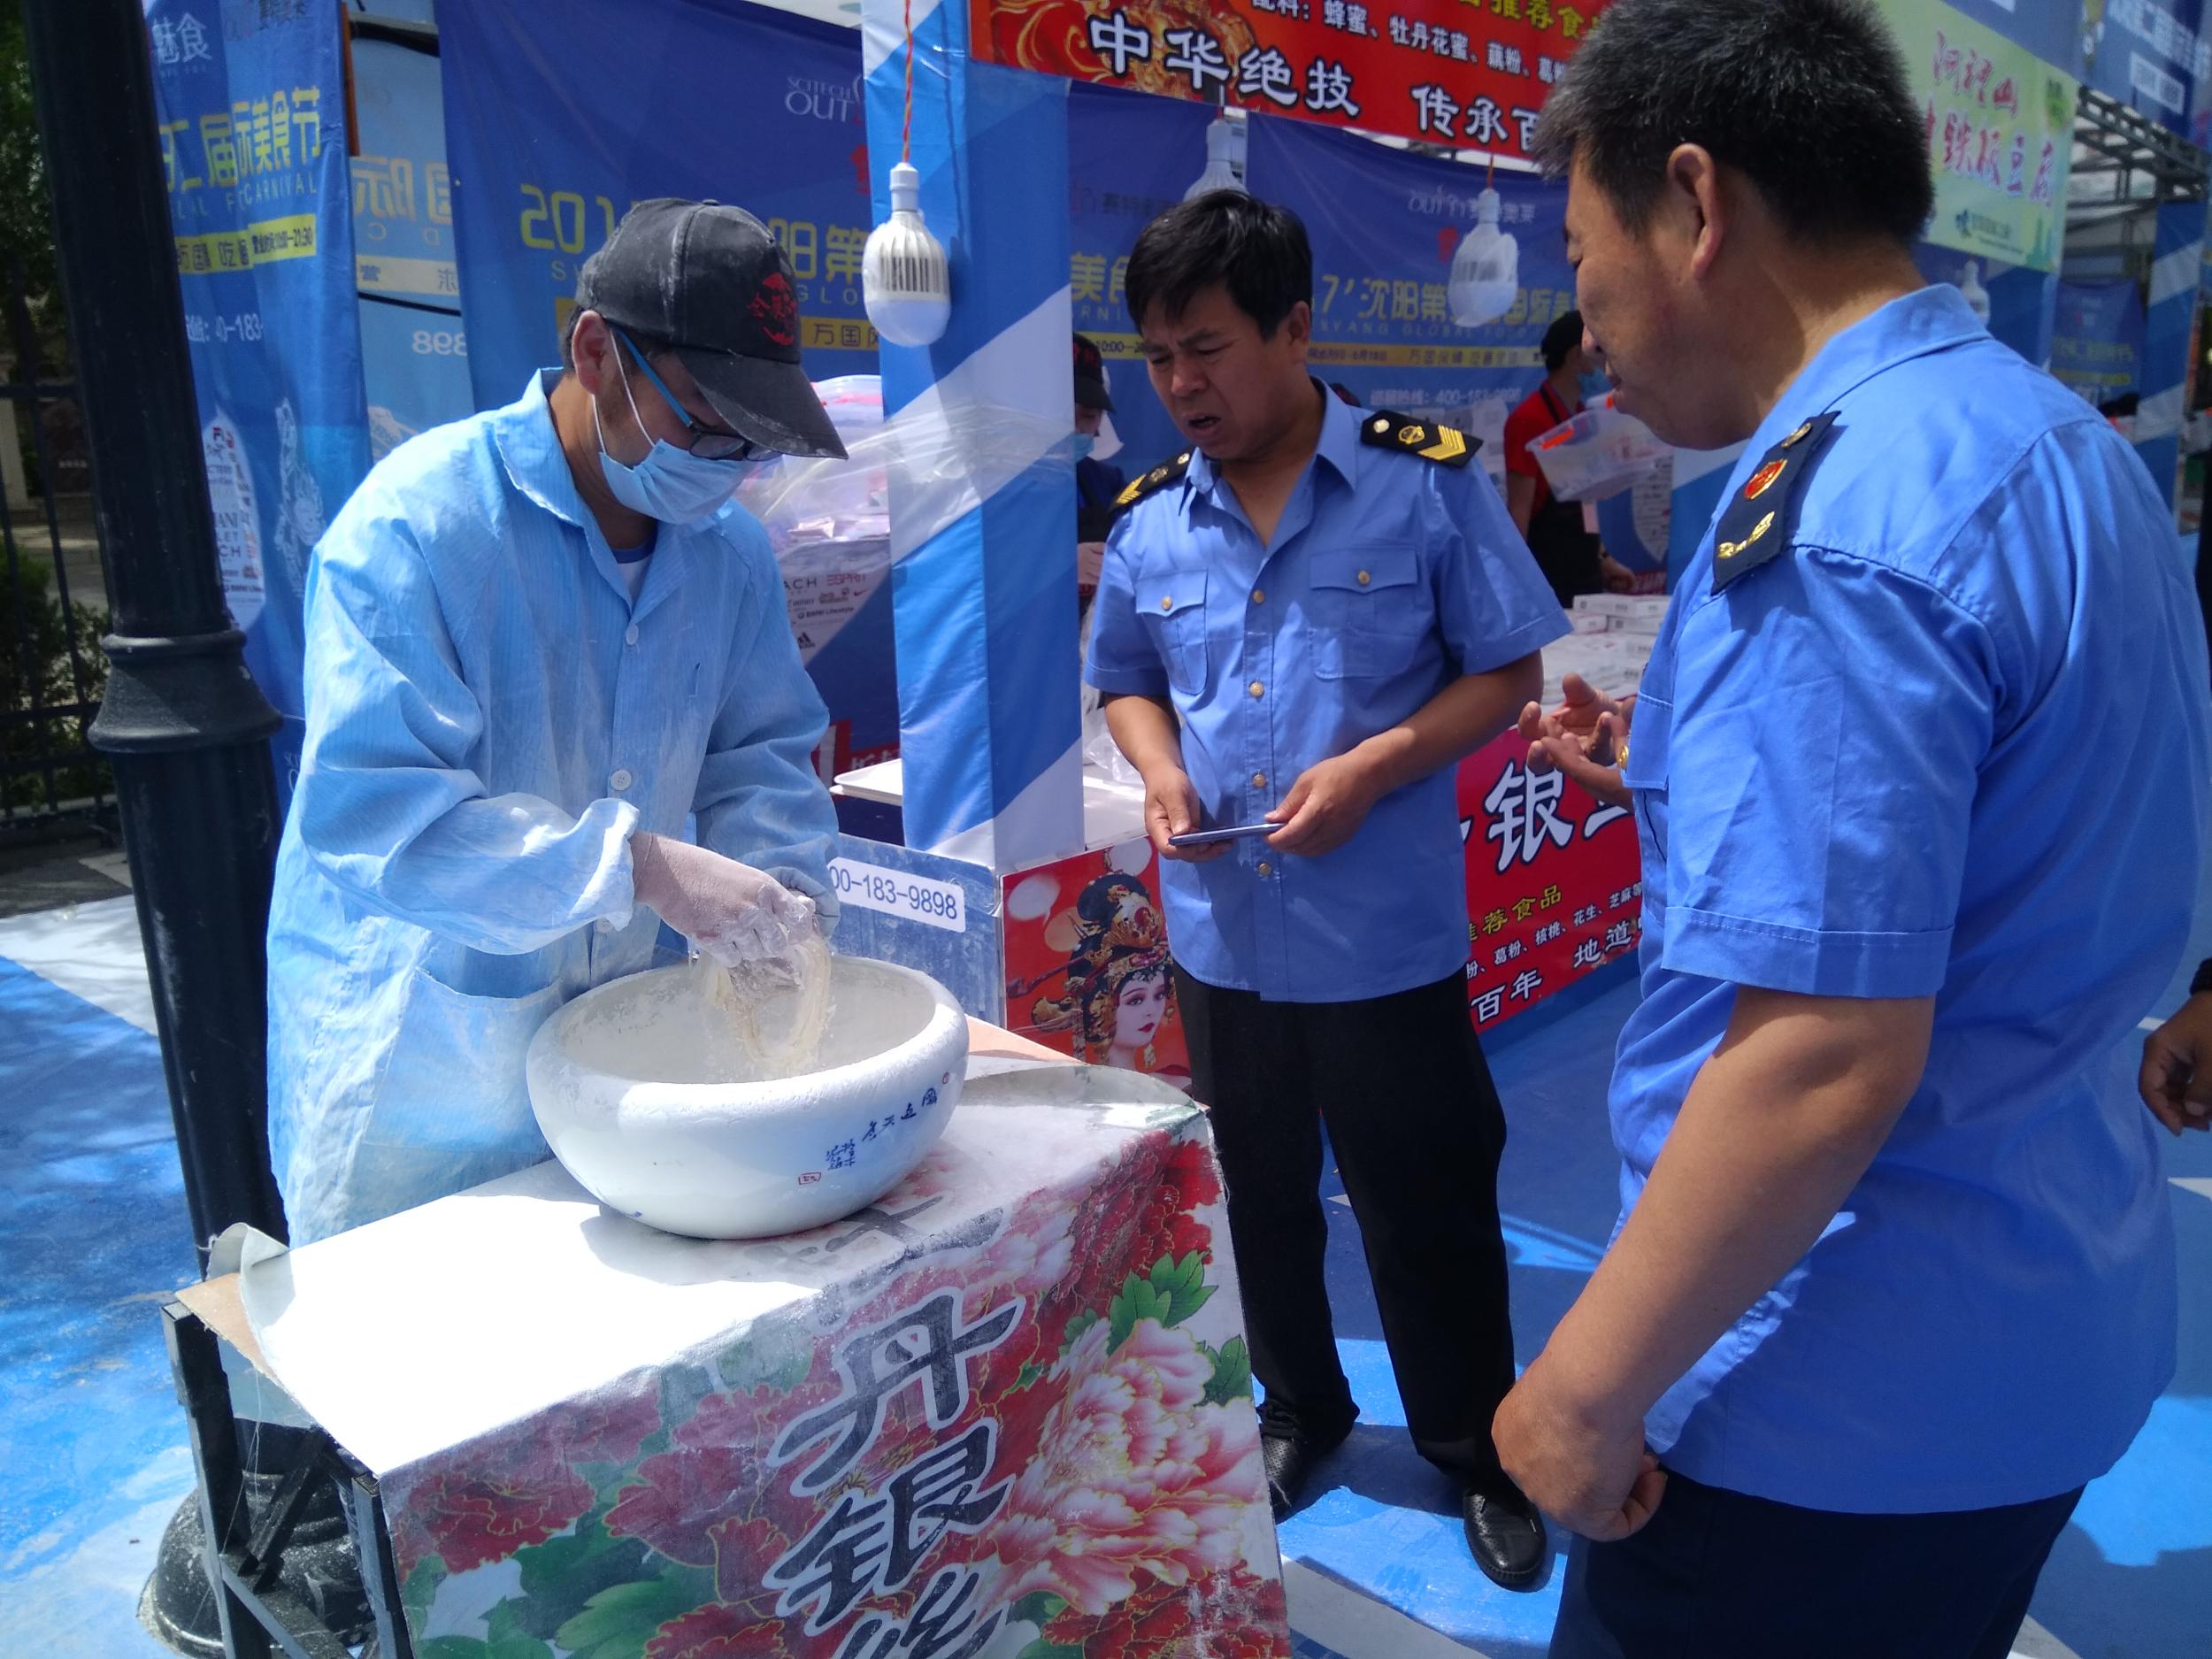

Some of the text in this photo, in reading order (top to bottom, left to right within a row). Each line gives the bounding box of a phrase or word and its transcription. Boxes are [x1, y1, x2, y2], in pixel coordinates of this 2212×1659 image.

[1460, 0, 1585, 39] 推荐食
[1089, 12, 1361, 117] 中华绝技
[1471, 968, 1543, 1023] 百年
